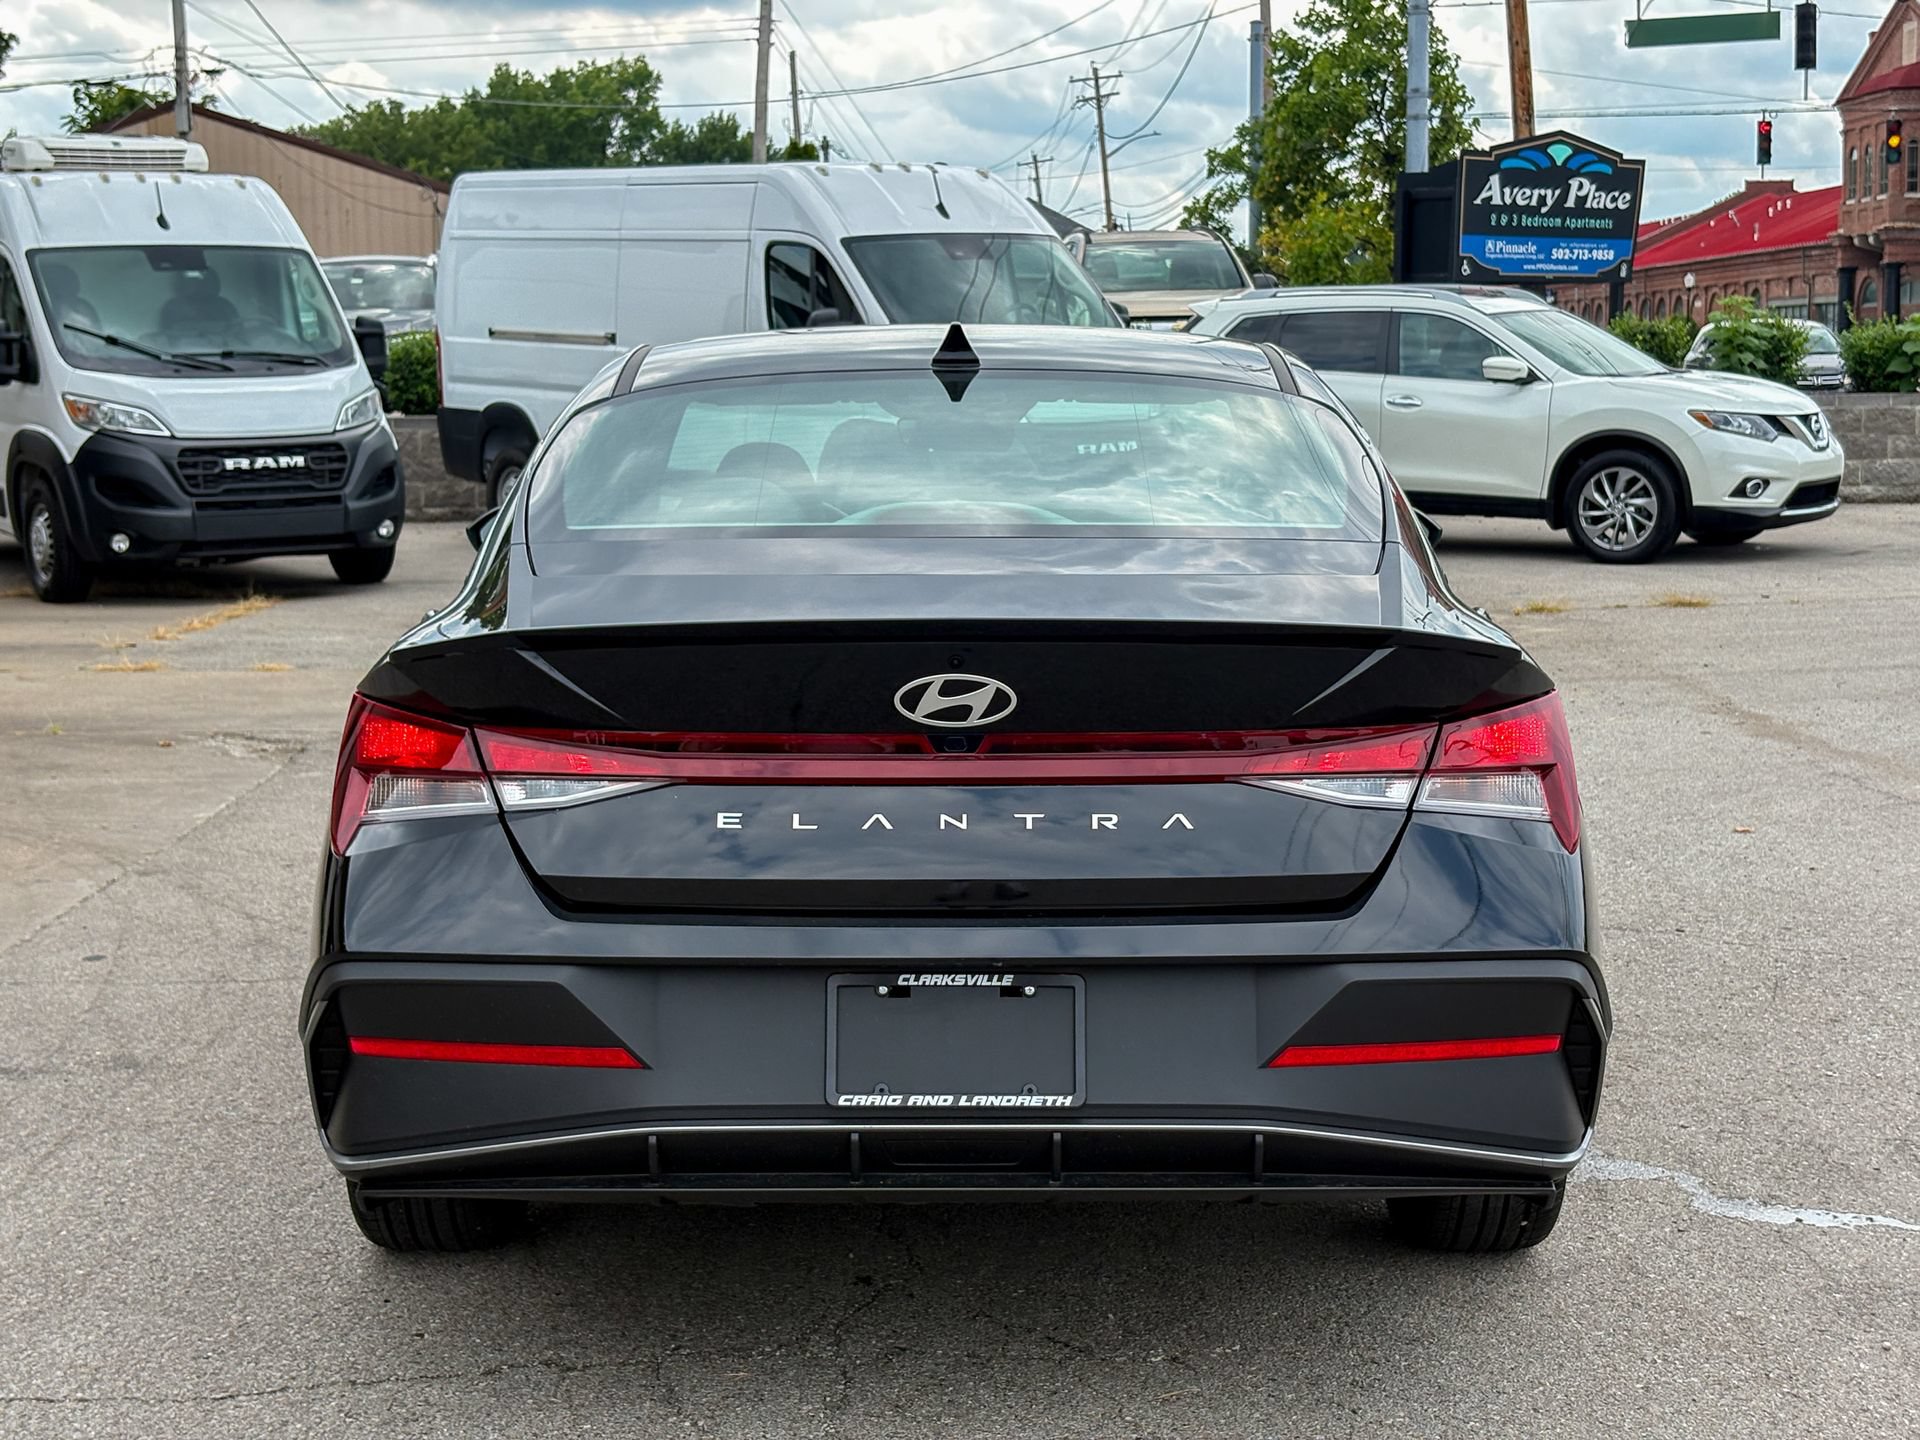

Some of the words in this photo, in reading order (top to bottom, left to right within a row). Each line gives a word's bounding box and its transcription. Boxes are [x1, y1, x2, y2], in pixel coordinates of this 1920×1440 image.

[1473, 173, 1562, 214] Avery
[1564, 177, 1632, 211] Place
[1490, 213, 1497, 226] 2
[1511, 214, 1518, 227] 3
[1521, 215, 1562, 228] Bedroom
[1564, 216, 1613, 230] Apartments
[1495, 240, 1537, 254] Pinnacle
[1550, 248, 1615, 261] 502-713-9858
[223, 455, 305, 471] RAM
[715, 812, 1195, 830] ELANTRA
[897, 974, 1015, 986] CLARKSVILLE
[837, 1094, 903, 1106] CRAIG
[906, 1094, 954, 1106] AND
[957, 1094, 1074, 1107] LANDRETH
